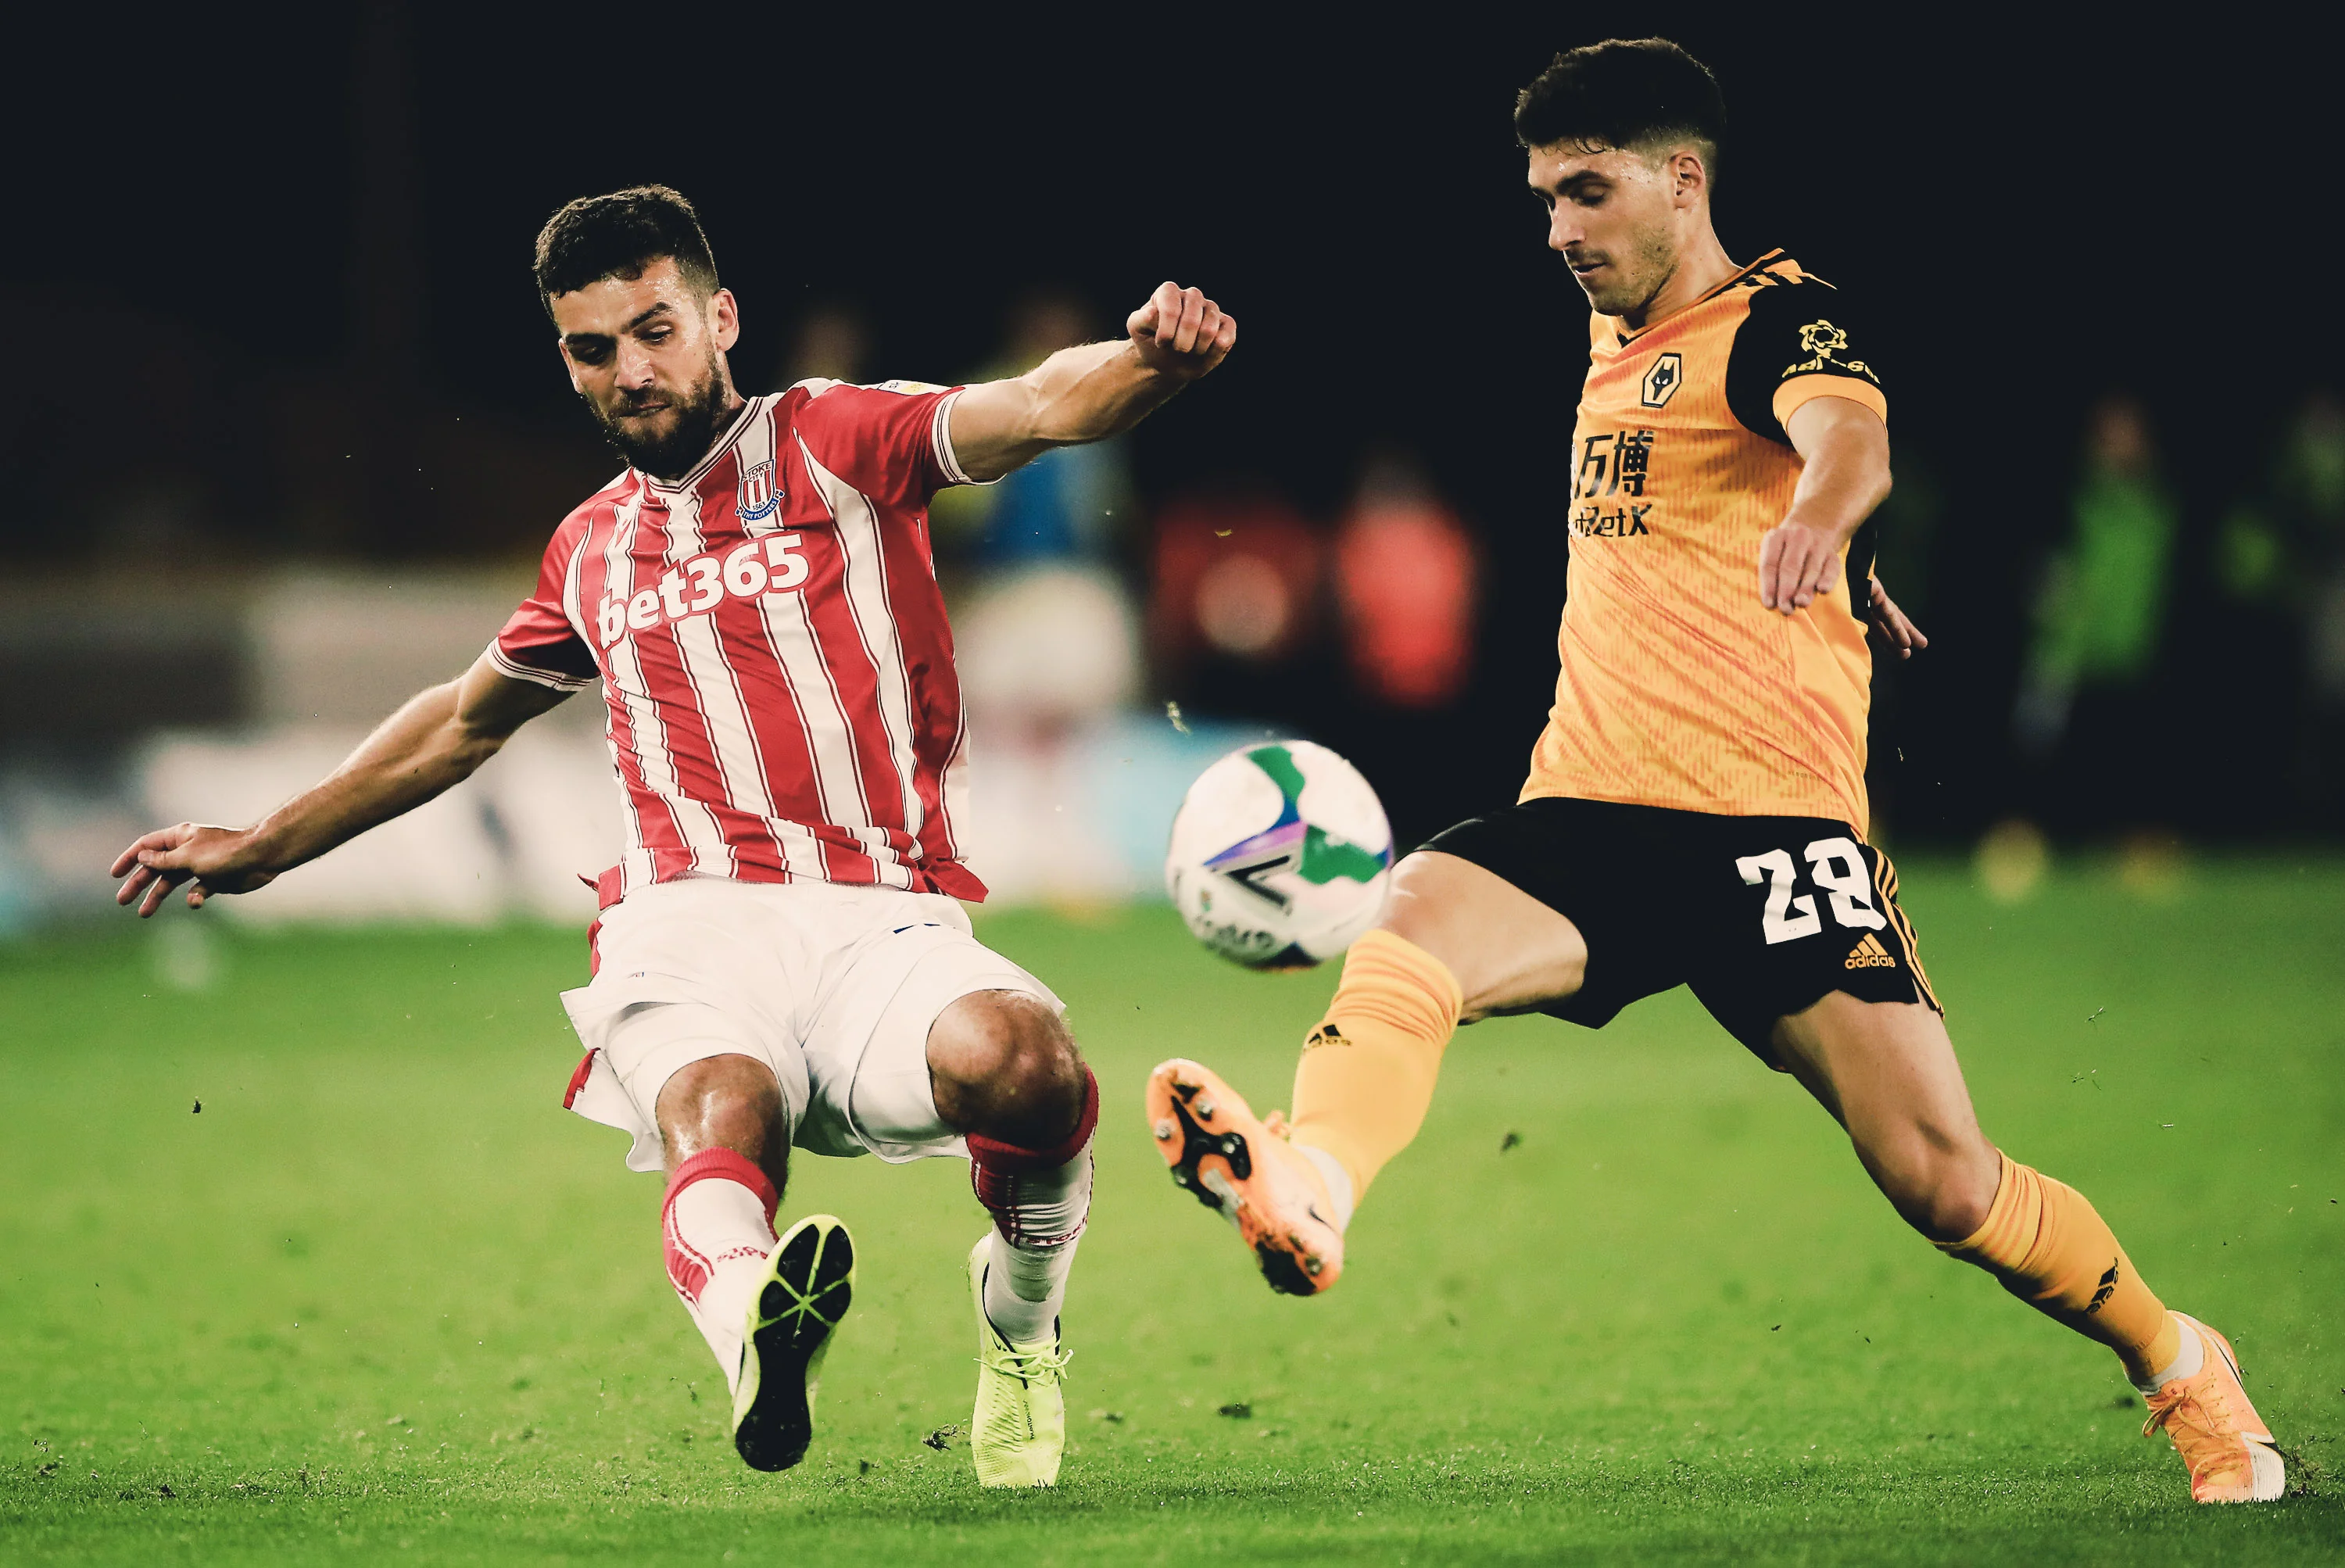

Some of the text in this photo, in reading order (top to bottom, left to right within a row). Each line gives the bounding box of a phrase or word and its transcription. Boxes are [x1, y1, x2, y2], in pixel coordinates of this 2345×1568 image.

[743, 462, 772, 481] STOKE
[1574, 430, 1654, 499] 万博
[748, 471, 764, 482] CITY
[754, 499, 777, 519] POTTERS
[598, 533, 811, 650] bet365
[1735, 837, 1888, 945] 28
[1845, 954, 1896, 969] adidas
